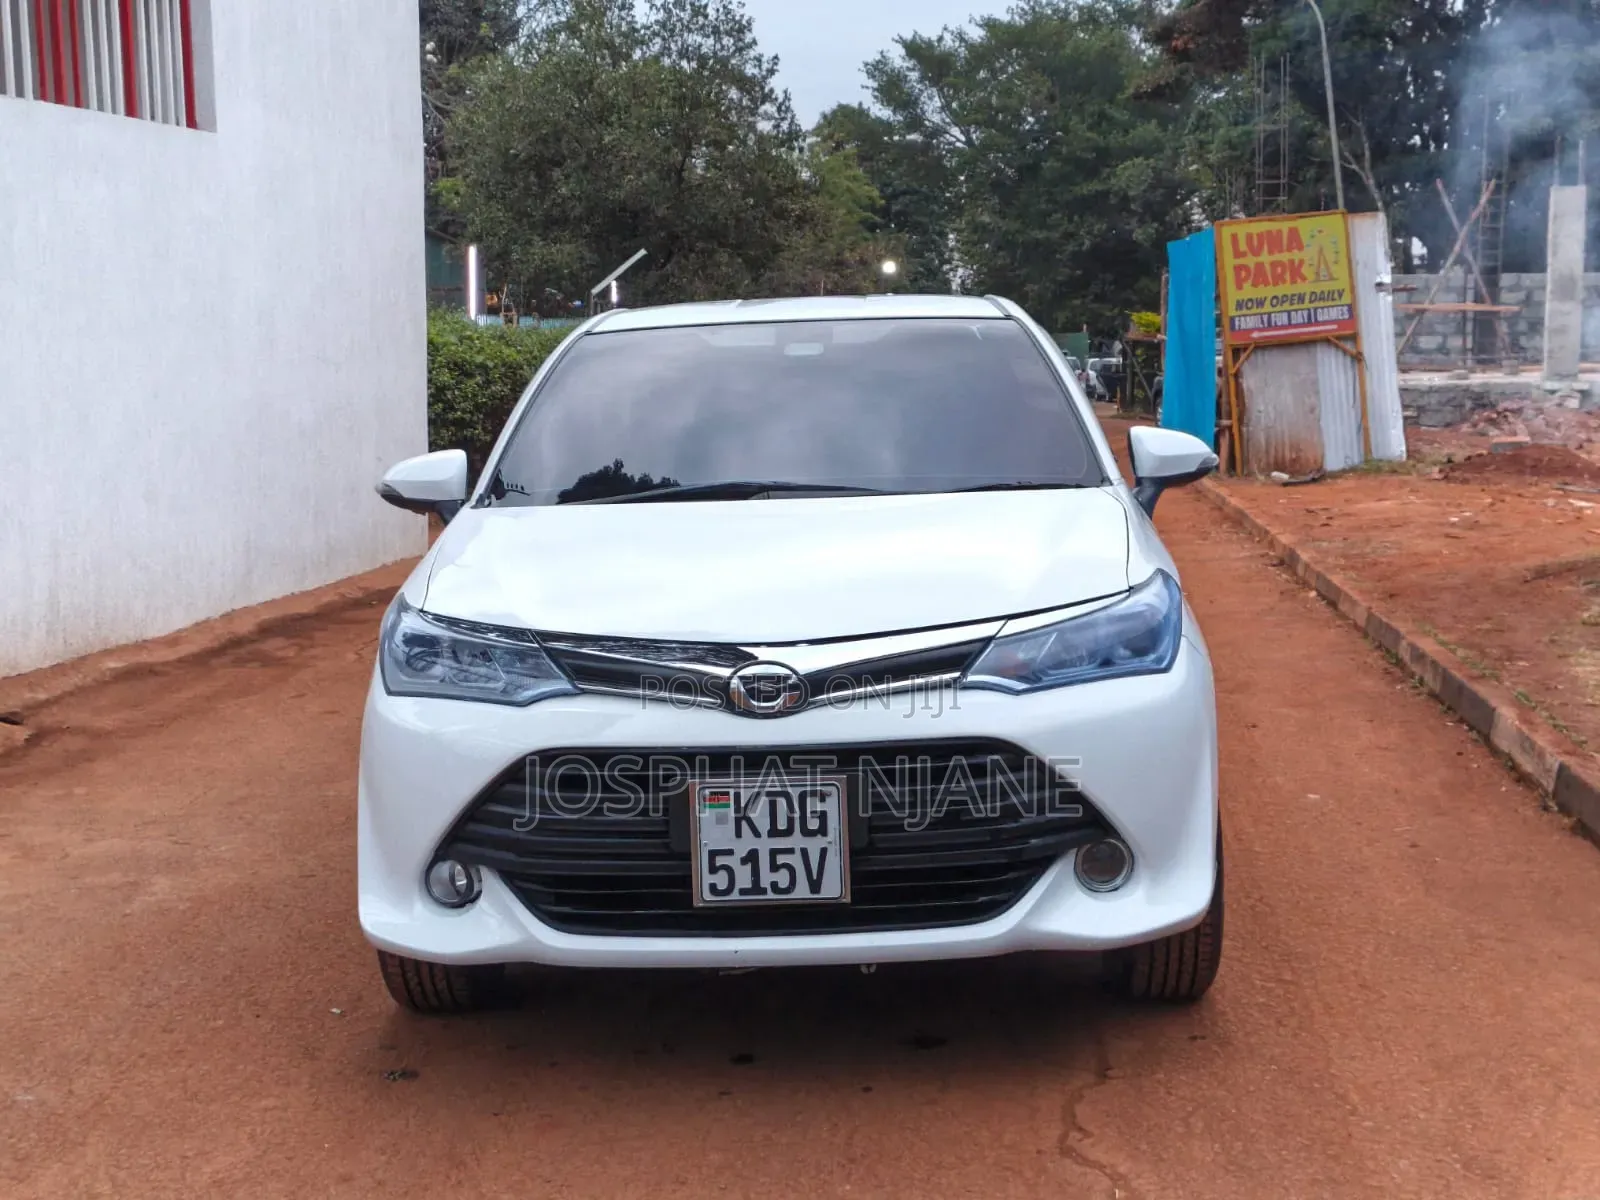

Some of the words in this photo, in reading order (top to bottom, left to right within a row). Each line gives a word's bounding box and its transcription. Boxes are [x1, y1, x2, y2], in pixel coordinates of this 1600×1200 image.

[1230, 226, 1304, 259] LUNA
[1233, 258, 1308, 291] PARK
[1235, 296, 1268, 312] NOW
[1270, 291, 1306, 308] OPEN
[1309, 288, 1345, 304] DAILY
[1235, 314, 1270, 330] FAMILY
[1271, 311, 1289, 327] FUN
[1290, 309, 1309, 325] DAY
[1317, 305, 1349, 321] GAMES
[734, 789, 828, 838] KDG
[707, 847, 828, 896] 515V
